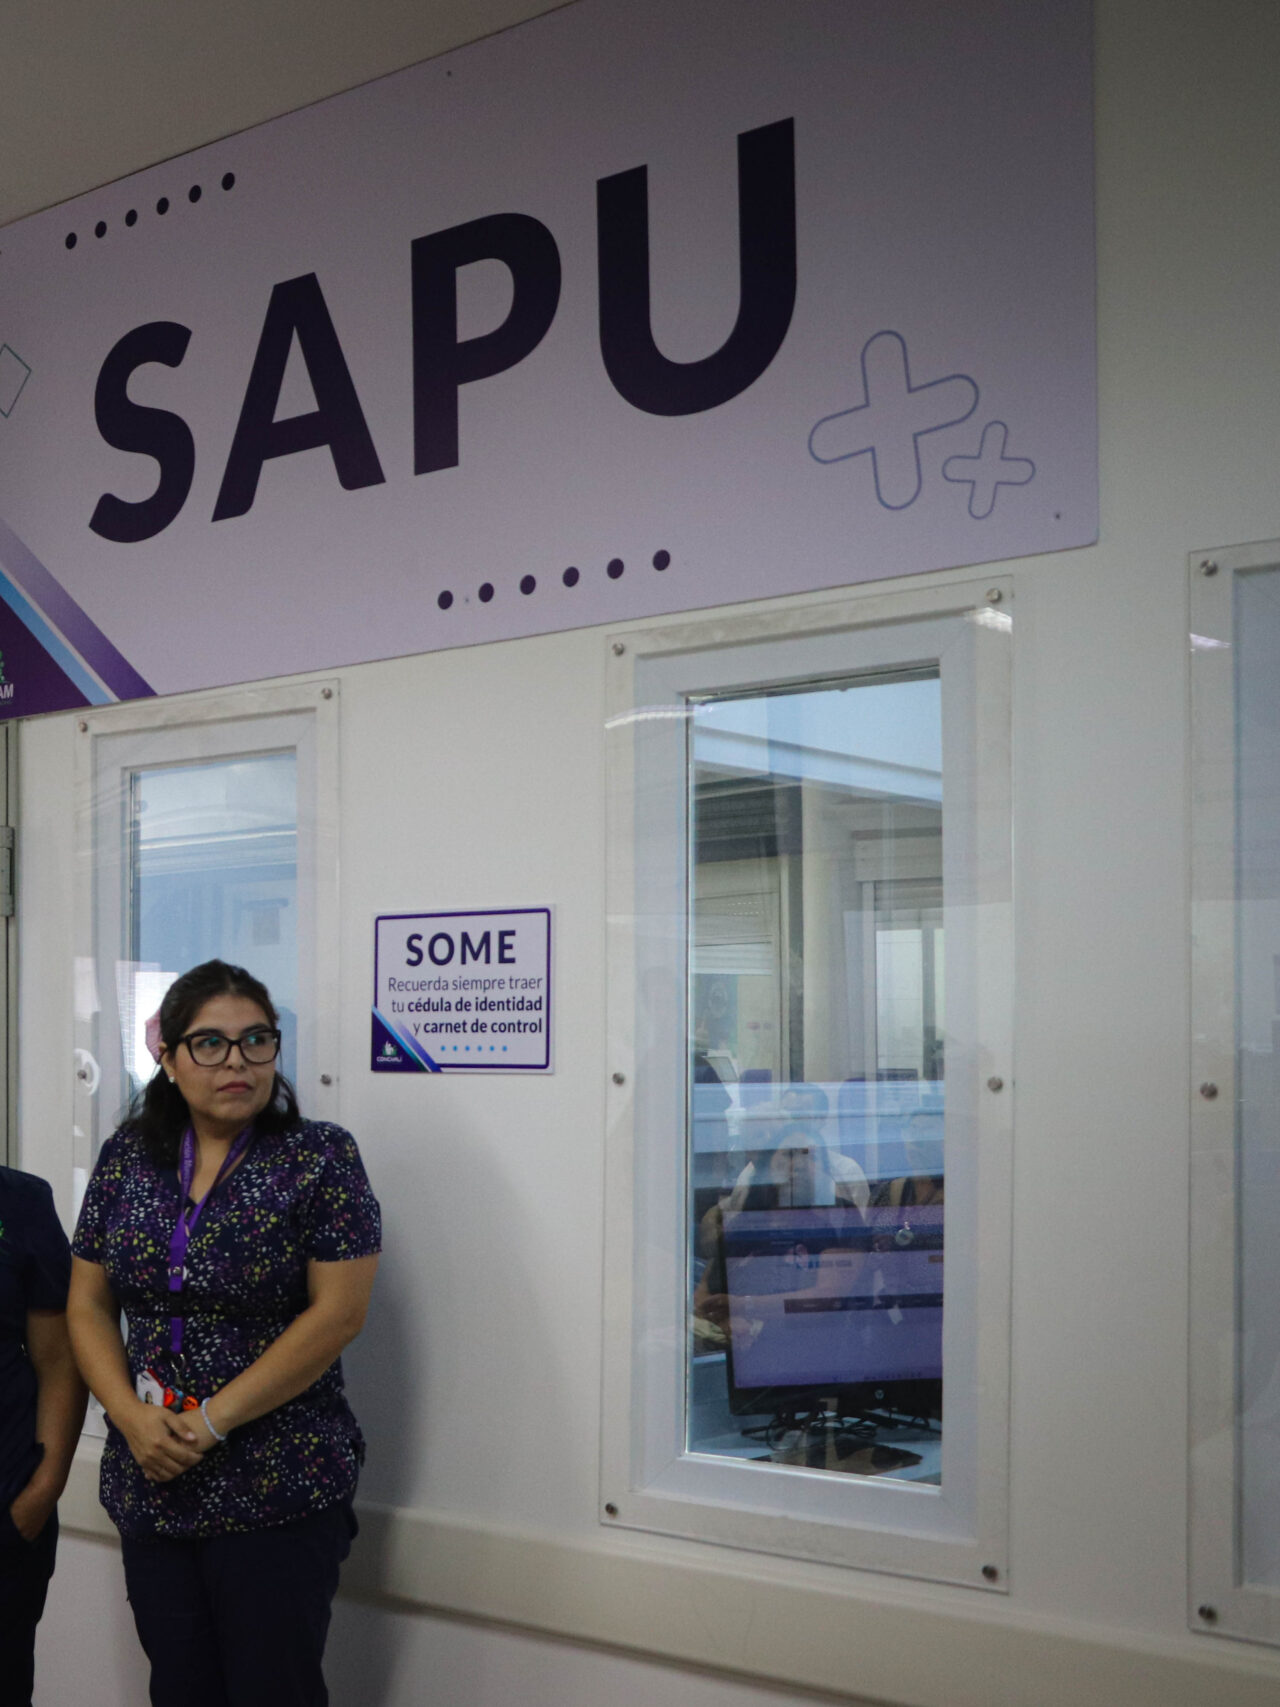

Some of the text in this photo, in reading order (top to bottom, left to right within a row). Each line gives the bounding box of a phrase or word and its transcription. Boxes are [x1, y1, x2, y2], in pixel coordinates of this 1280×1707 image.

[89, 117, 797, 543] SAPU
[406, 930, 516, 967] SOME
[388, 976, 543, 993] Recuerda siempre traer
[392, 993, 543, 1013] tu cédula de identidad
[413, 1018, 543, 1036] y carnet de control
